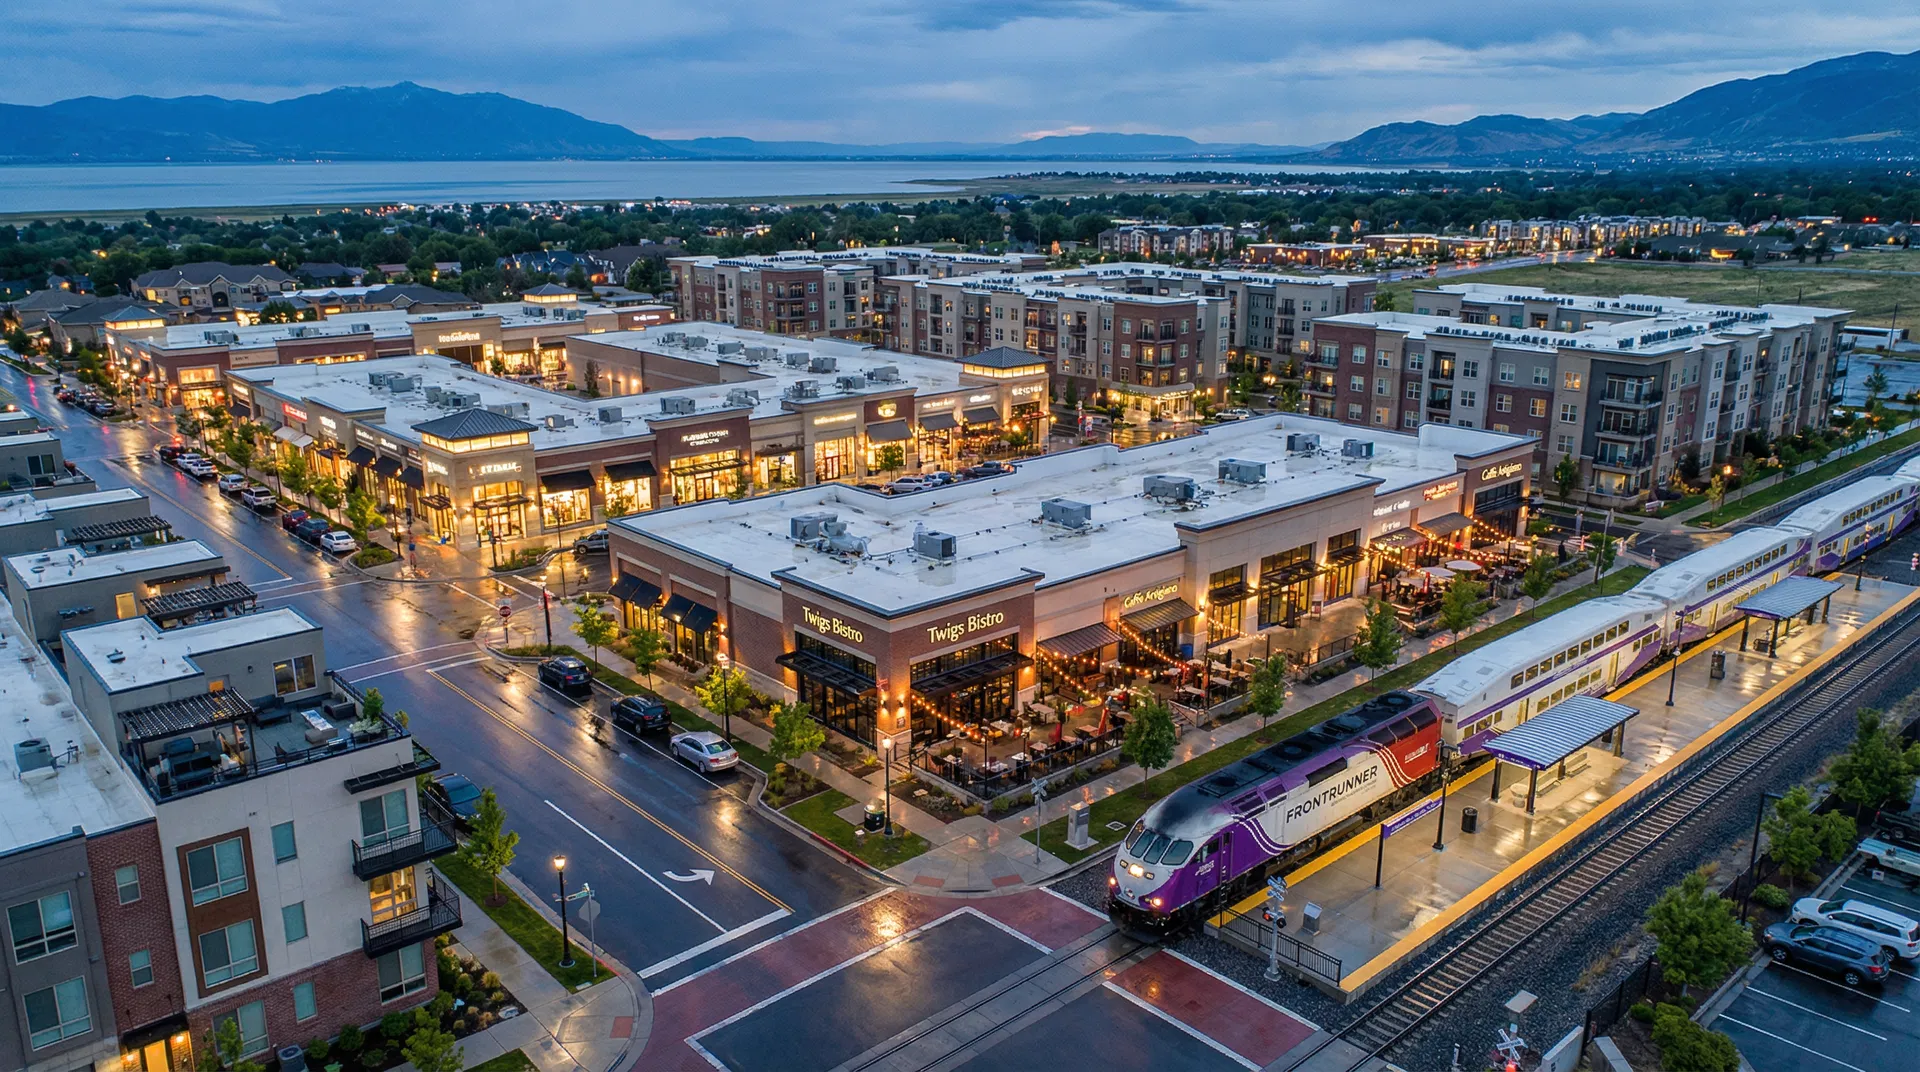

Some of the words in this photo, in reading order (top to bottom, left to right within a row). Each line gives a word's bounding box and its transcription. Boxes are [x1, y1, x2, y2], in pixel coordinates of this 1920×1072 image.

[802, 606, 831, 634] Twigs
[832, 618, 863, 643] Bistro
[927, 622, 965, 644] Twigs
[967, 611, 1004, 632] Bistro
[1286, 765, 1378, 824] FRONTRUNNER
